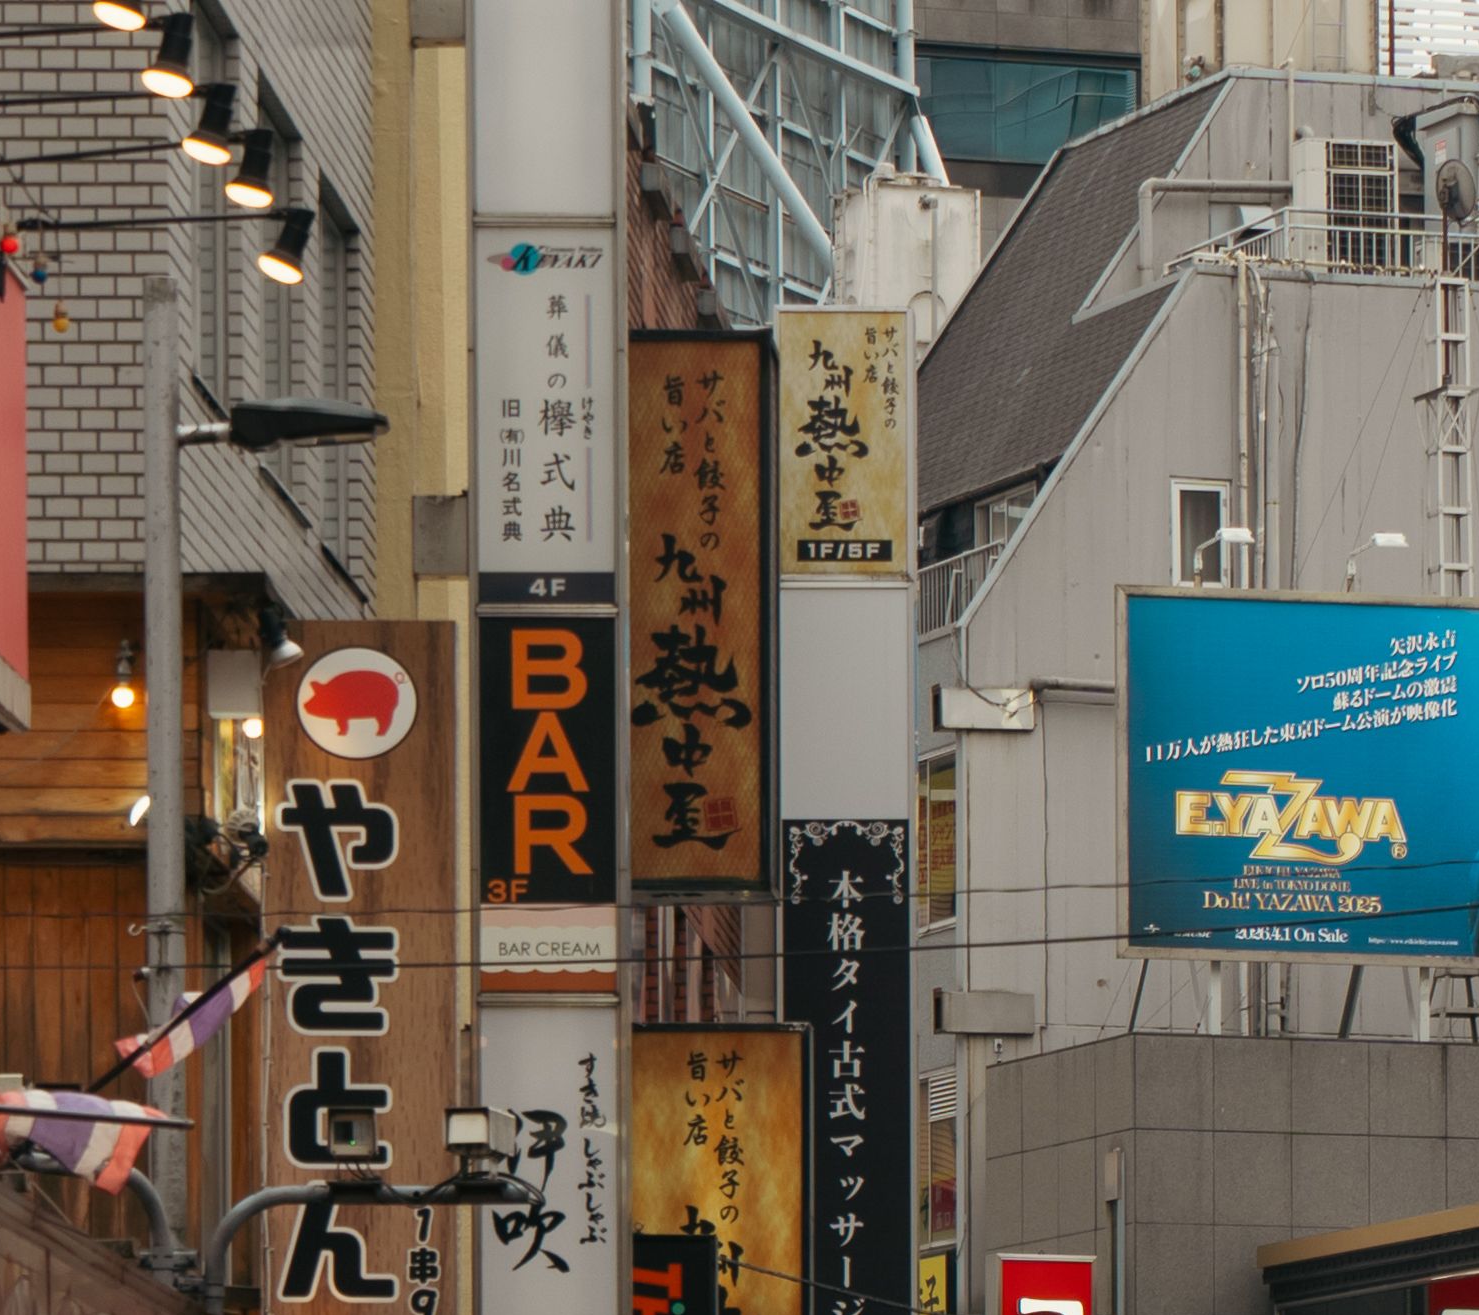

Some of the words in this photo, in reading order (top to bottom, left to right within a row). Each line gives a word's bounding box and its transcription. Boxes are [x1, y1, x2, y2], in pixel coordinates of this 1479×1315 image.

[879, 326, 901, 430] サバと餃子の
[693, 370, 726, 551] サバと餃子の
[806, 542, 880, 560] 1F/5F
[529, 578, 567, 597] 4F
[1389, 628, 1457, 657] 矢沢永吉
[1296, 651, 1458, 694] ソロ50周年記念ライブ
[1332, 674, 1458, 712] 蘇るドームの激震
[507, 628, 594, 875] BAR
[487, 878, 529, 903] 3F
[1233, 878, 1259, 891] LIVE
[1275, 879, 1314, 892] TOKYO
[1315, 880, 1351, 893] DOME
[1255, 892, 1334, 913] YAZAWA
[1337, 895, 1382, 914] 2025
[498, 941, 530, 957] BAR
[535, 941, 601, 957] CREAM
[1293, 927, 1315, 942] On
[1317, 928, 1349, 943] Sale
[277, 780, 400, 1304] やきとん
[712, 1049, 746, 1225] サバと餃子の
